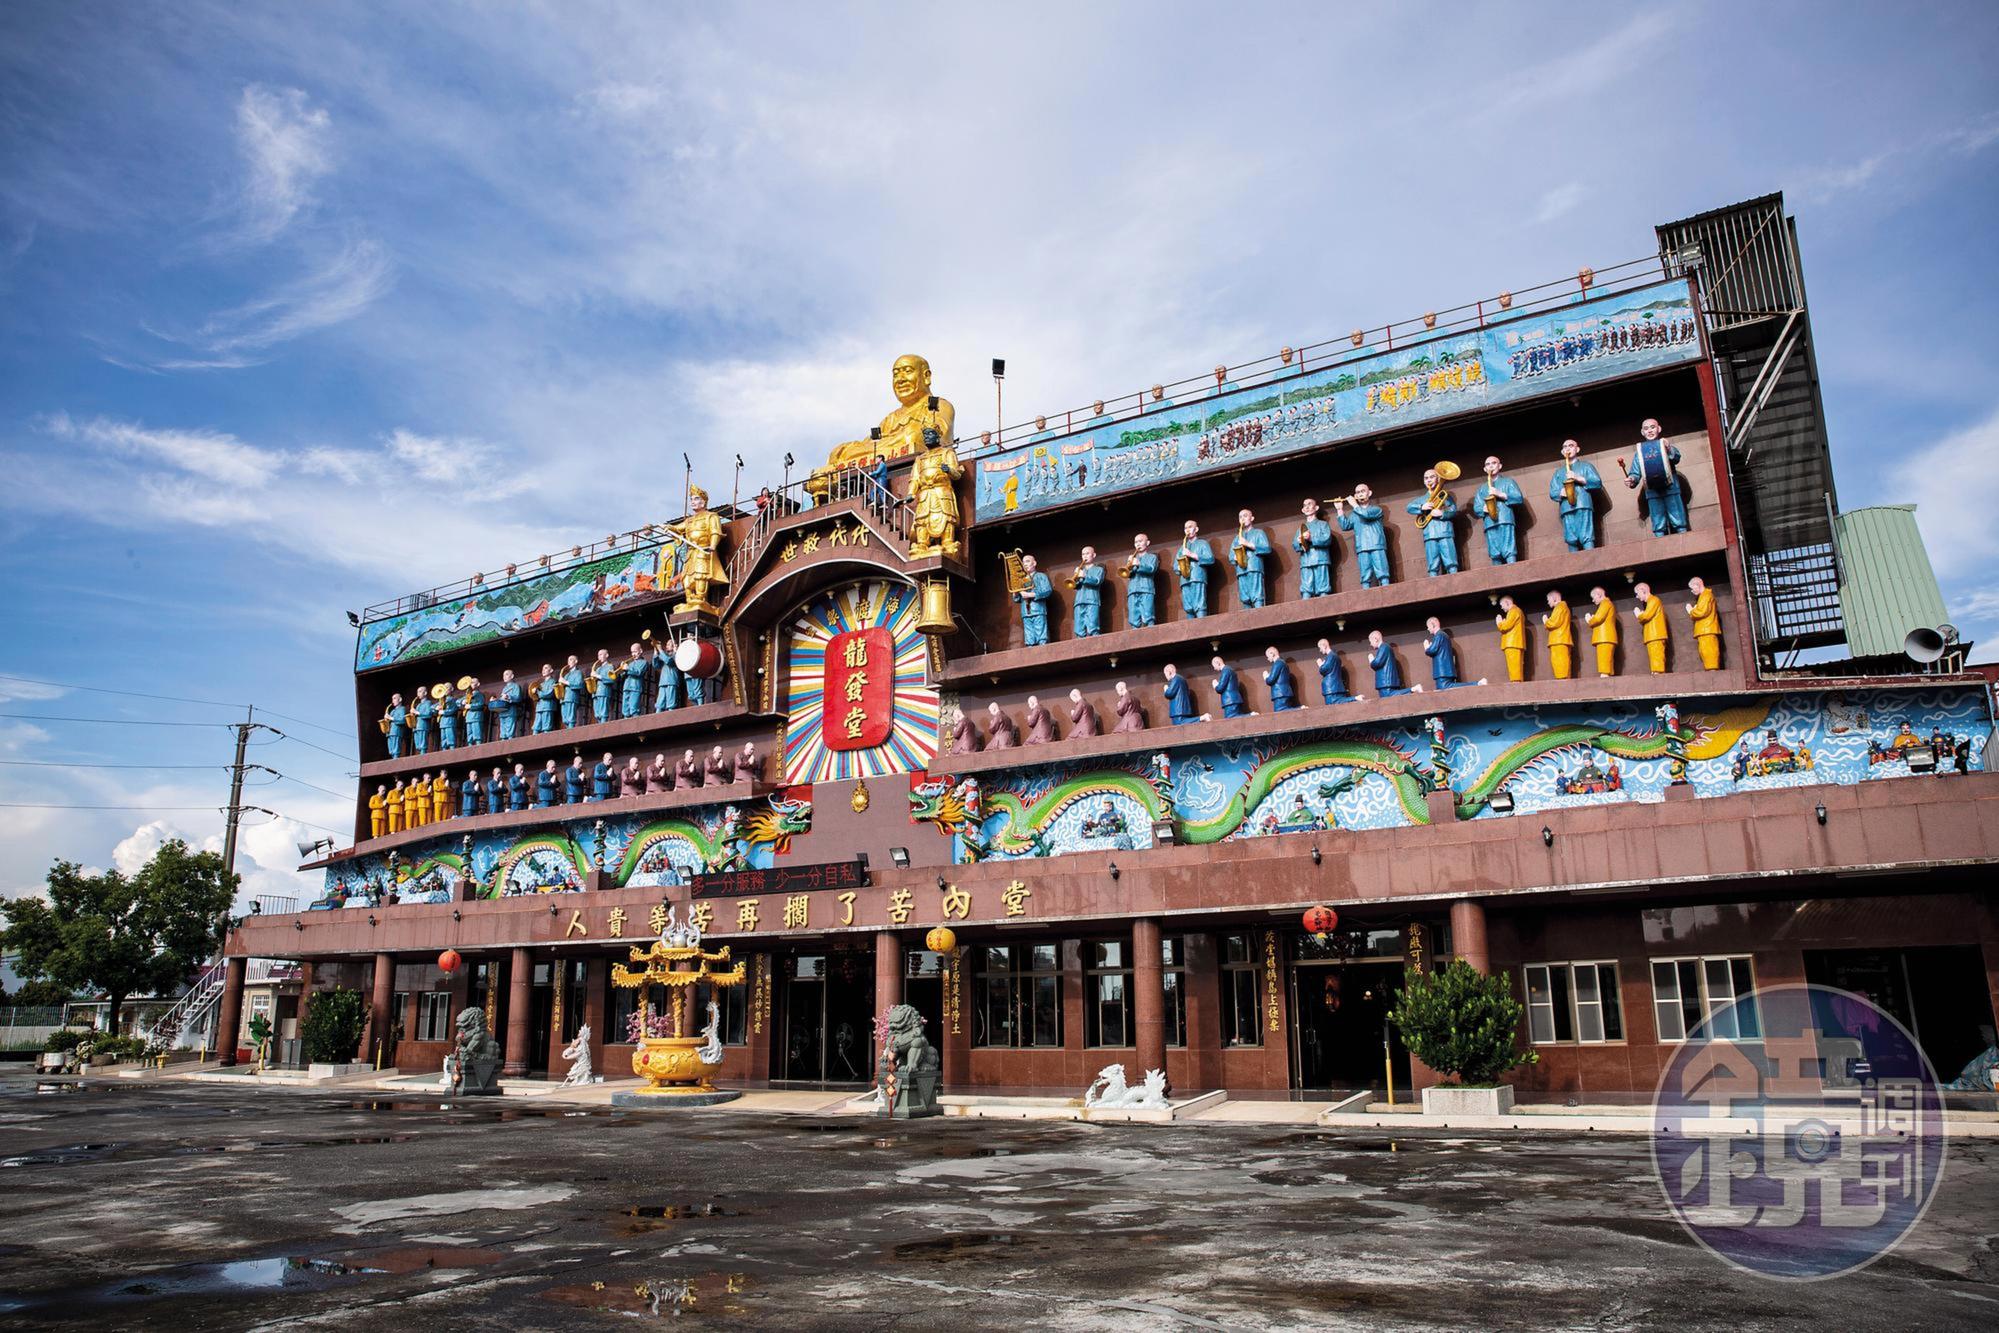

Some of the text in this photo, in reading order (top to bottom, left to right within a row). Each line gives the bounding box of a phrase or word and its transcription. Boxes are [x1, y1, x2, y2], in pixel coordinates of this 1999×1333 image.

[843, 637, 869, 739] 龍發堂
[691, 863, 857, 896] 多一分服務 少一分自私
